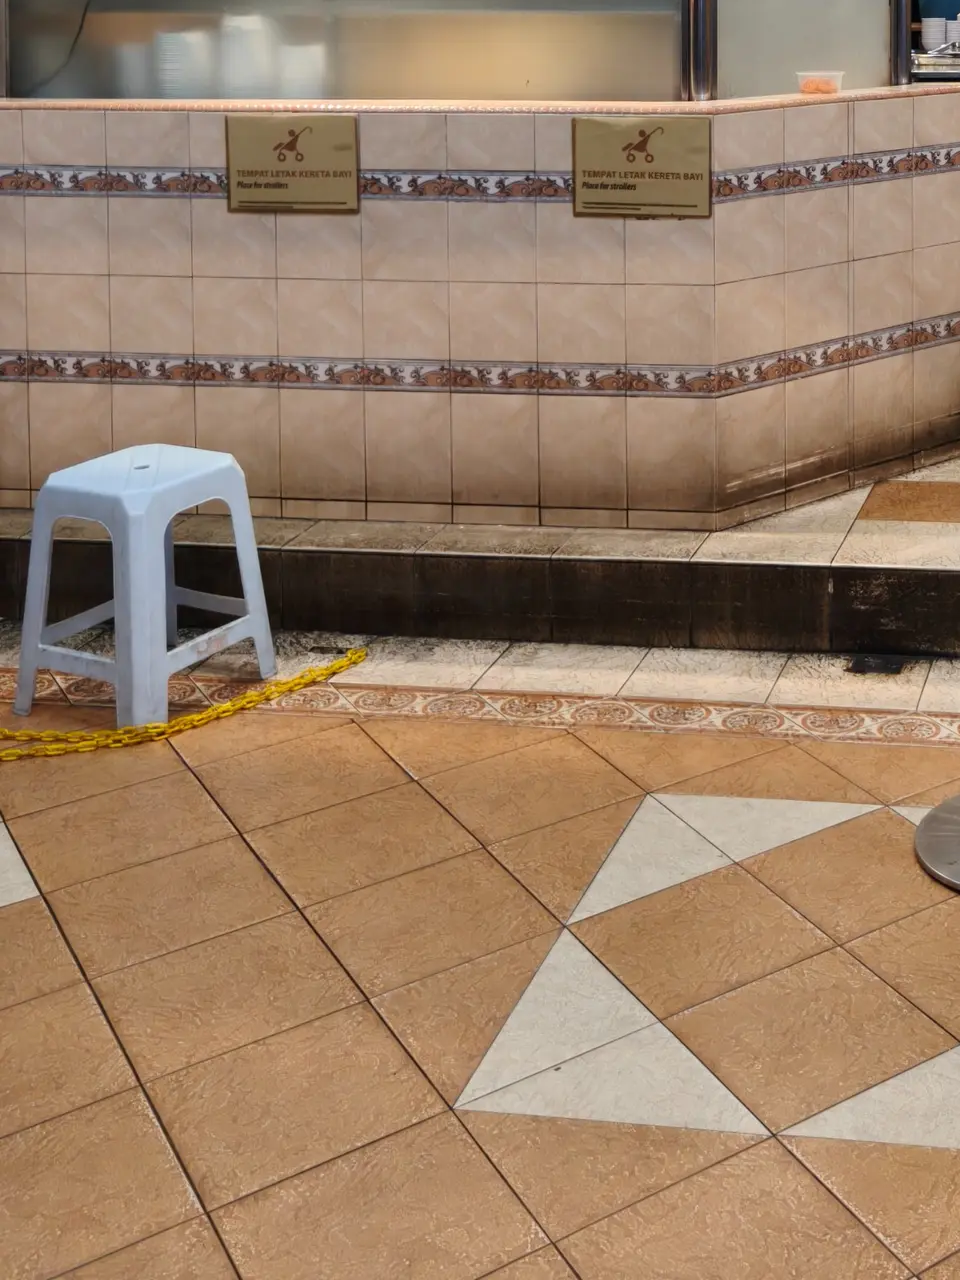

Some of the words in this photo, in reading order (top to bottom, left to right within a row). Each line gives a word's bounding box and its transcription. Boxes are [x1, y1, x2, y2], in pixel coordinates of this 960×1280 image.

[237, 170, 269, 178] TEMPAT
[271, 170, 297, 178] LETAK
[299, 170, 331, 178] KERETA
[332, 170, 352, 178] BAYI
[582, 170, 617, 178] TEMPAT
[619, 171, 646, 179] LETAK
[648, 172, 681, 180] KERETA
[683, 173, 703, 181] BAYI
[237, 181, 253, 189] Place
[600, 182, 610, 190] for
[610, 183, 637, 191] strollers
